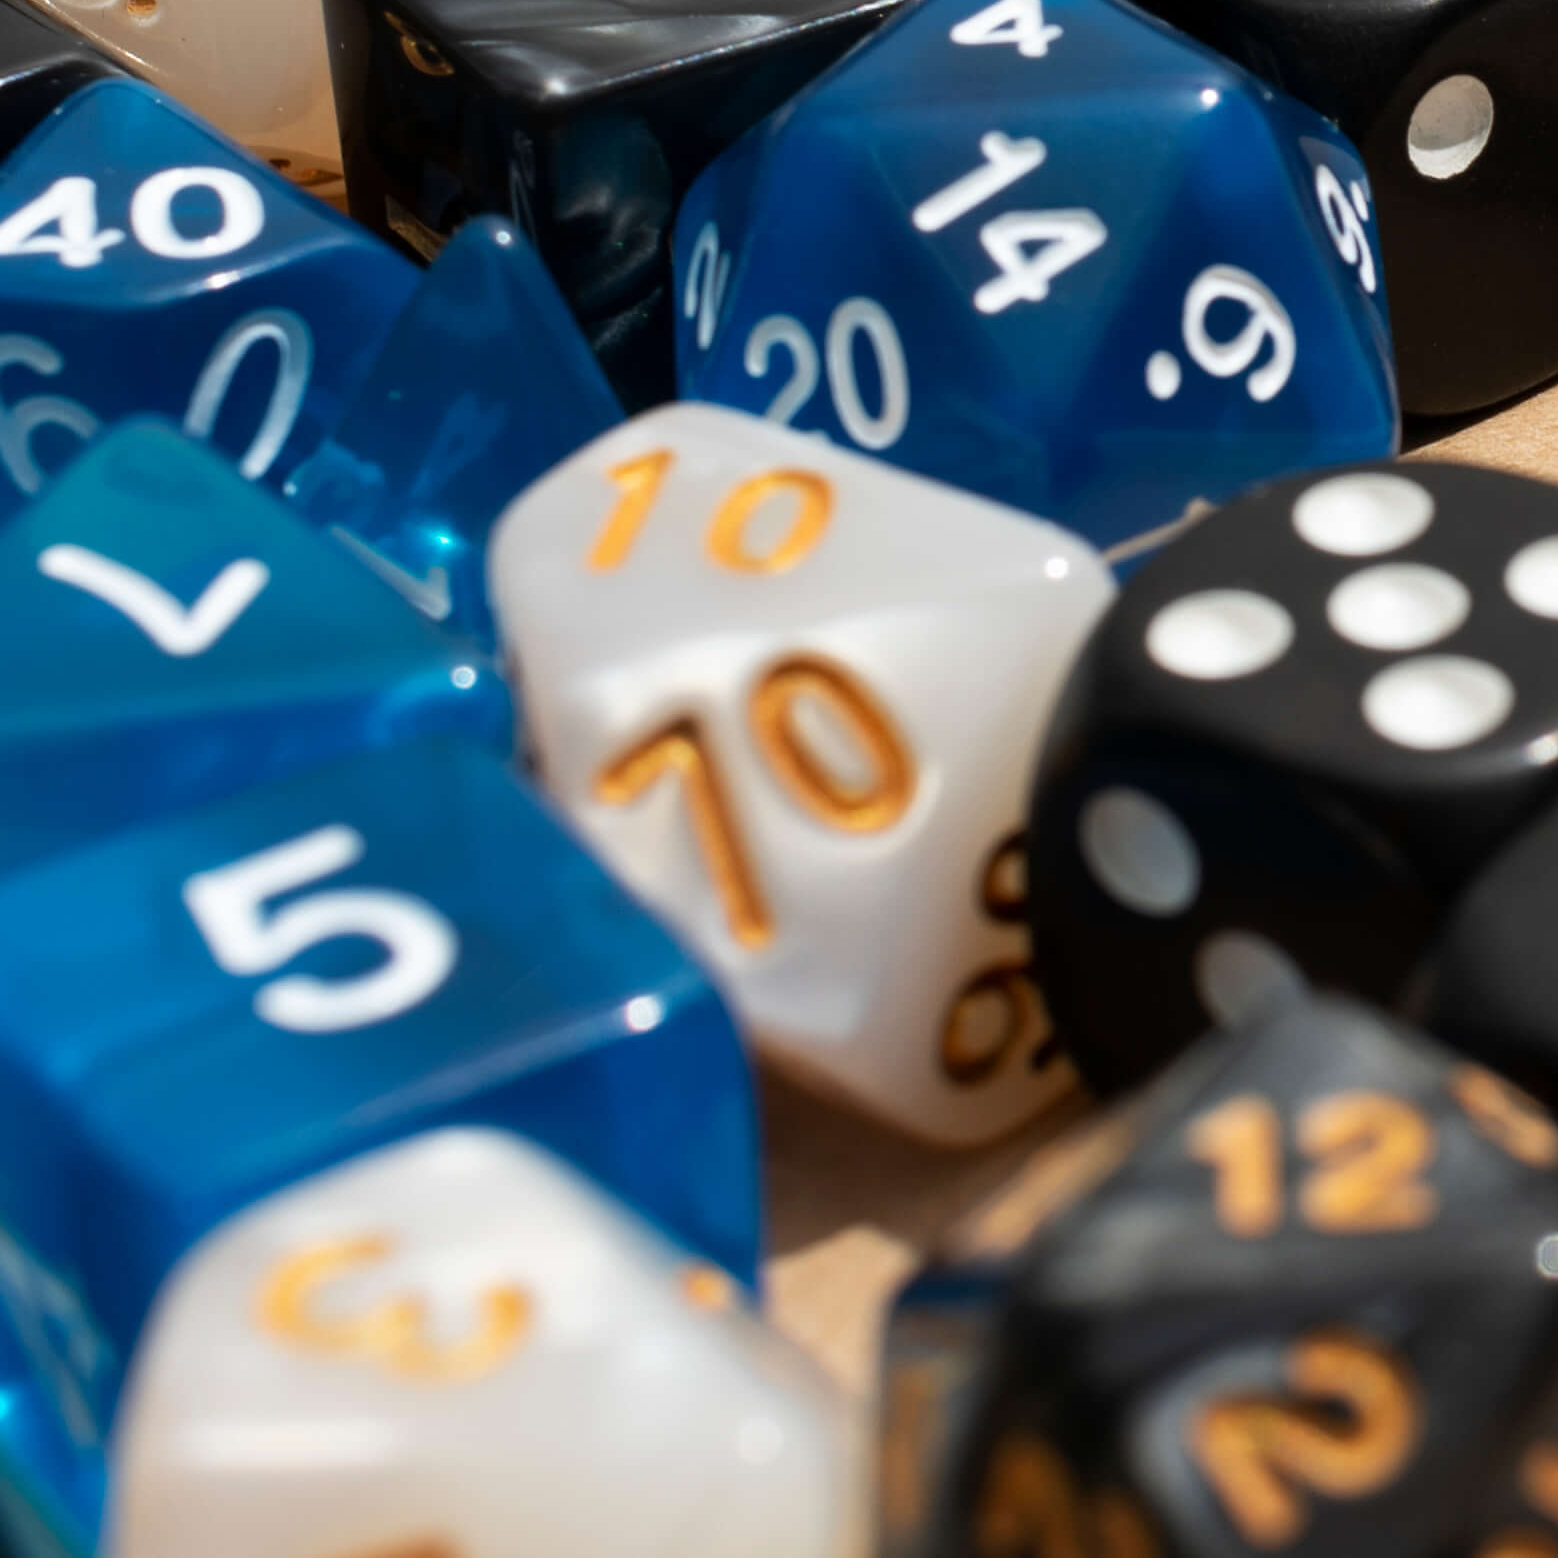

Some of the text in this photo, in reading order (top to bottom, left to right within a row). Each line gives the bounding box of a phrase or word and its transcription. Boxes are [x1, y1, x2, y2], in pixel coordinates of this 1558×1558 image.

[0, 166, 265, 268] 40
[911, 130, 1108, 315] 14
[743, 296, 910, 450] 20
[586, 448, 836, 576] 10
[592, 652, 916, 946] 70
[182, 823, 460, 1034] 5
[1185, 1092, 1440, 1239] 12
[252, 1237, 532, 1388] 3
